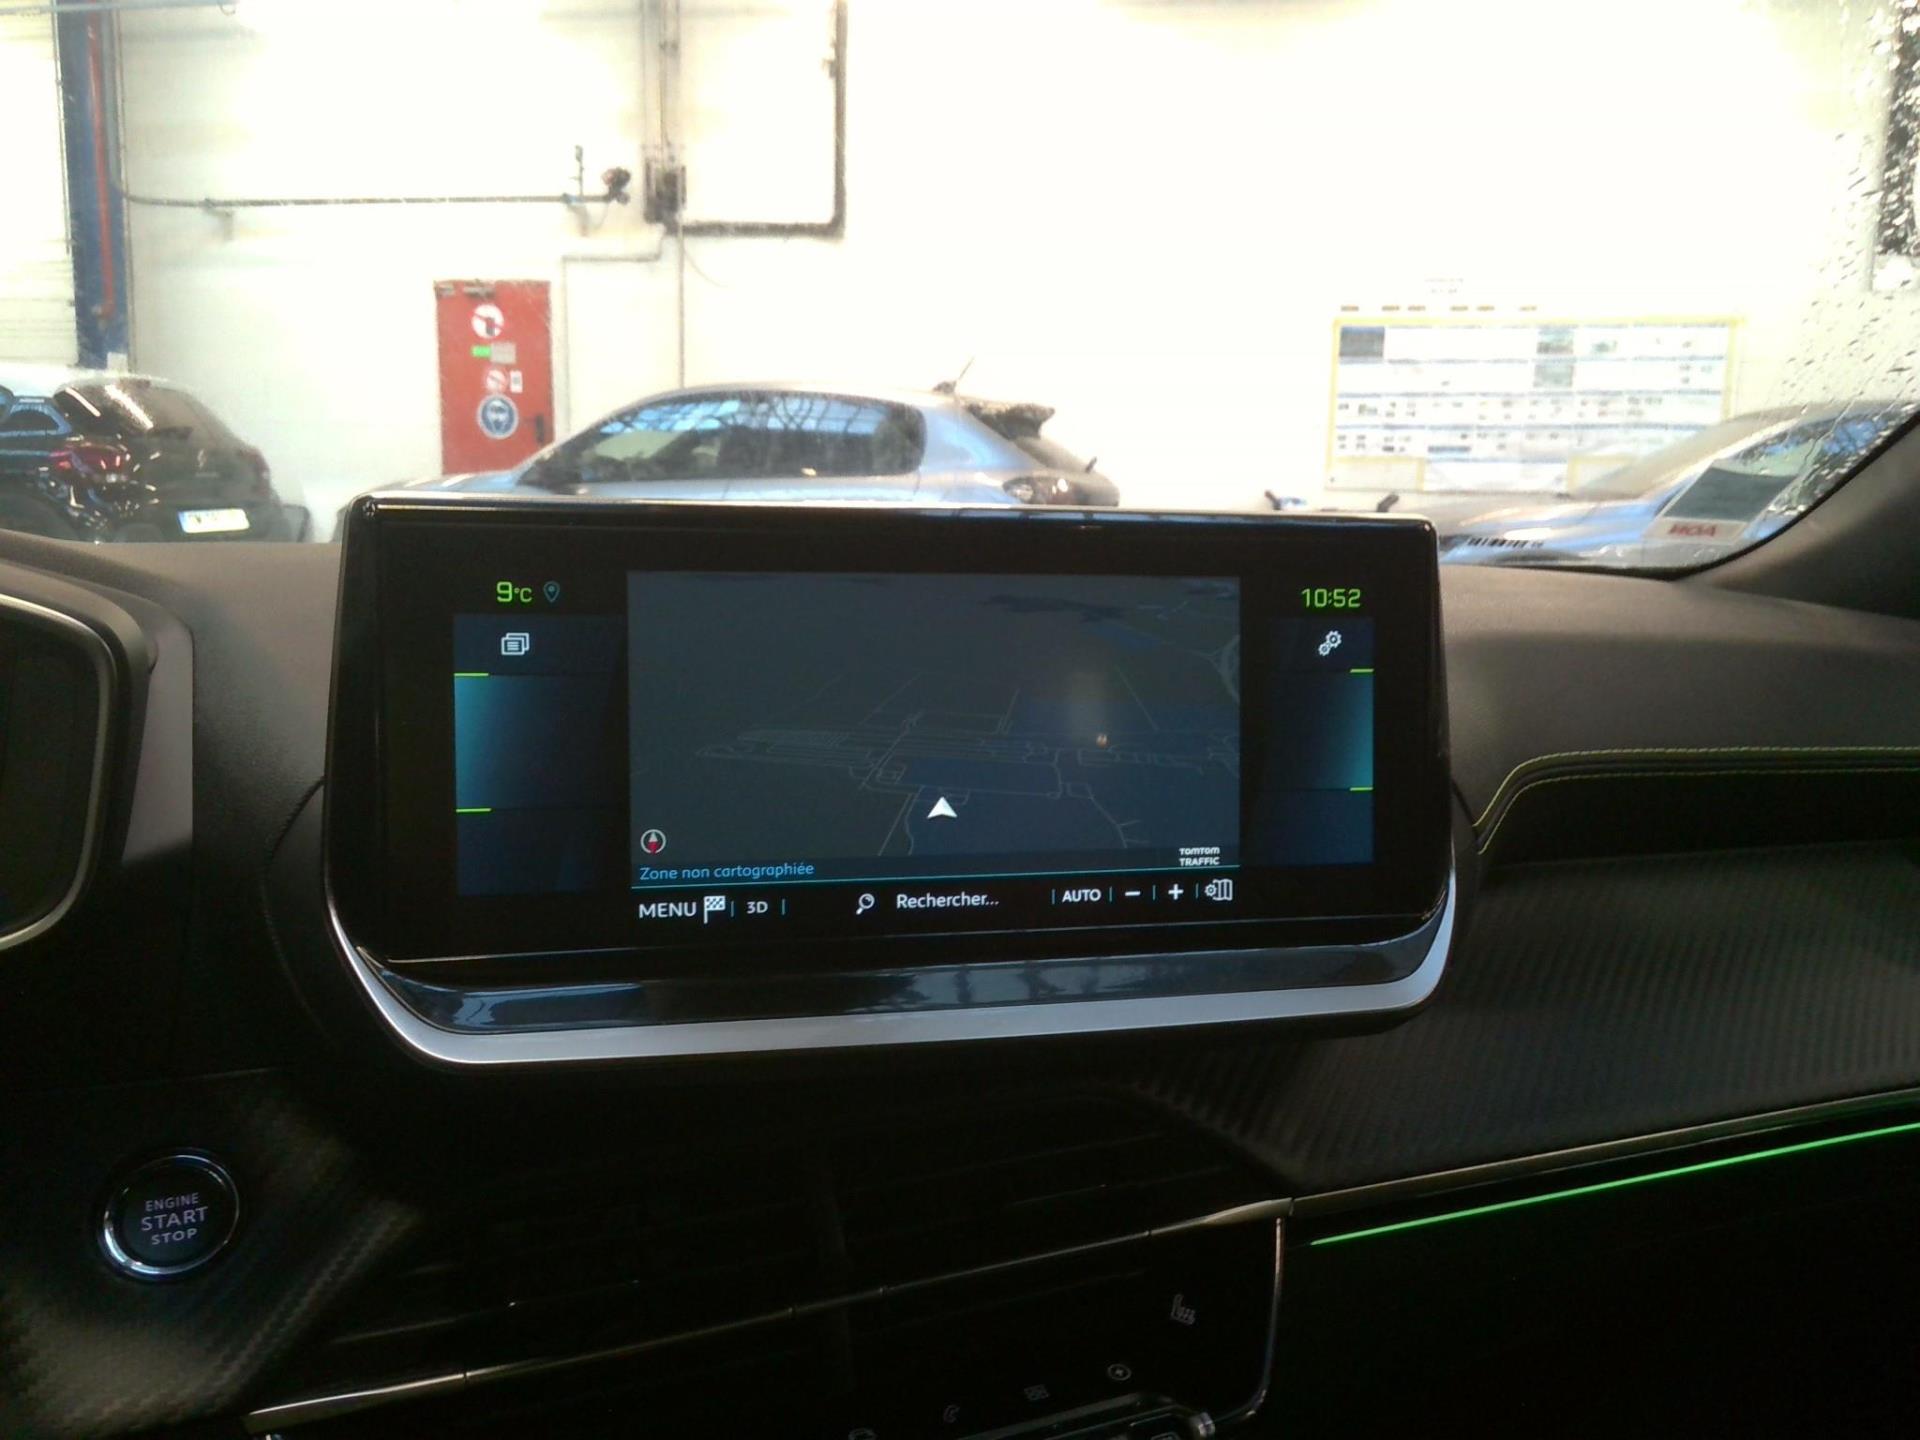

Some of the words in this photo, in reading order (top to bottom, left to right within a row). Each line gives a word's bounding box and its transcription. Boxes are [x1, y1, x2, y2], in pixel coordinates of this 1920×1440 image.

[1301, 588, 1362, 609] 10:52
[1178, 856, 1220, 867] TRAFFIC
[639, 866, 678, 881] Zone
[682, 867, 710, 879] non
[713, 862, 815, 881] cartographiée
[895, 891, 1000, 909] Rechercher...
[1061, 887, 1102, 904] AUTO
[638, 901, 697, 919] MENU
[746, 900, 769, 914] 3D
[145, 1192, 200, 1212] ENGINE
[141, 1205, 208, 1232] START
[151, 1227, 198, 1246] STOP
